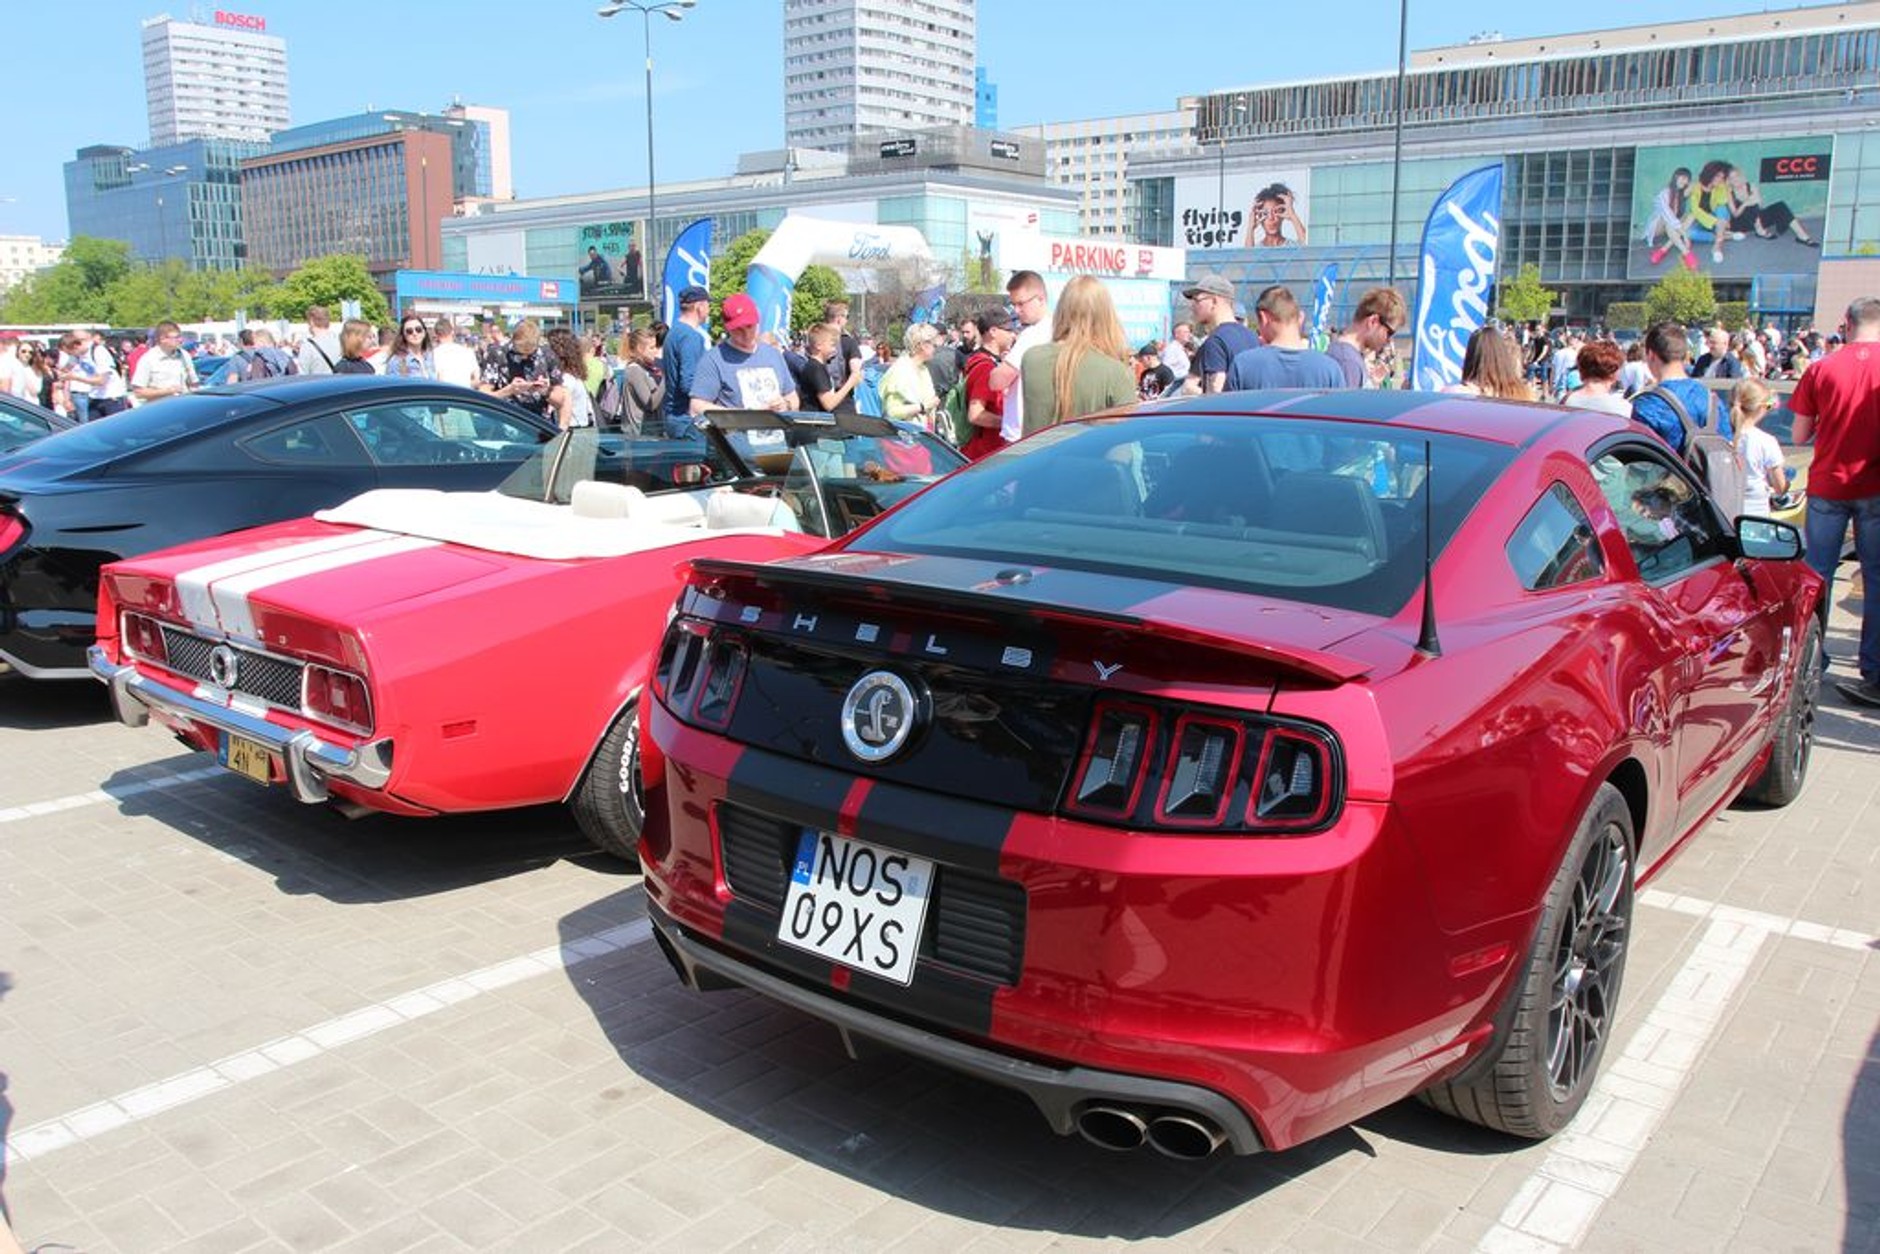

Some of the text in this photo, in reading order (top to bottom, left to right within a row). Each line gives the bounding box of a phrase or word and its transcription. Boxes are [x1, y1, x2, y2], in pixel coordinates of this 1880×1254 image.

[215, 10, 266, 31] BOSCH
[1776, 157, 1818, 174] CCC
[1182, 207, 1242, 230] flying
[1185, 226, 1238, 248] tiger
[1051, 243, 1127, 271] PARKING
[739, 605, 1124, 681] SHELBY
[796, 861, 809, 876] PL
[817, 835, 909, 907] NOS
[791, 892, 904, 970] 09XS
